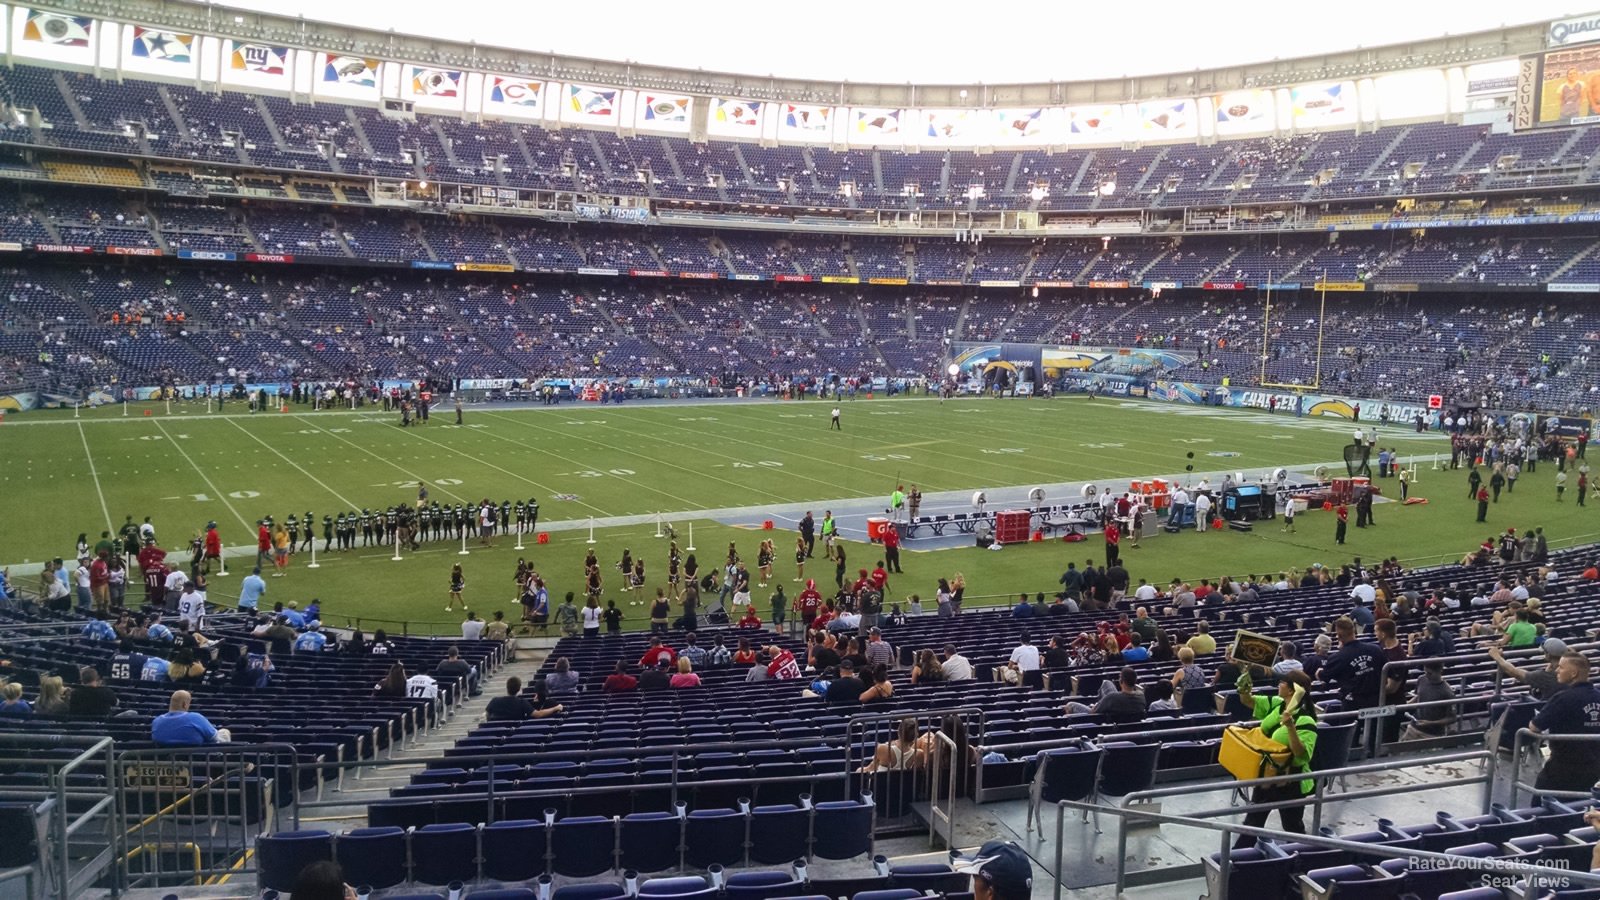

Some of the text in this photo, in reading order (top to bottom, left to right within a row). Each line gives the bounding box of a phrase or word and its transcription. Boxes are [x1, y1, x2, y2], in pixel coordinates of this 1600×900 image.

[1519, 61, 1532, 127] SYCUAN
[37, 244, 74, 252] TOSHIBA
[191, 251, 226, 260] GEICO
[256, 254, 285, 262] TOYOTA
[187, 490, 261, 502] 10
[878, 524, 886, 534] G
[149, 575, 158, 587] 11
[1349, 655, 1373, 667] ELITE
[410, 686, 426, 697] 17
